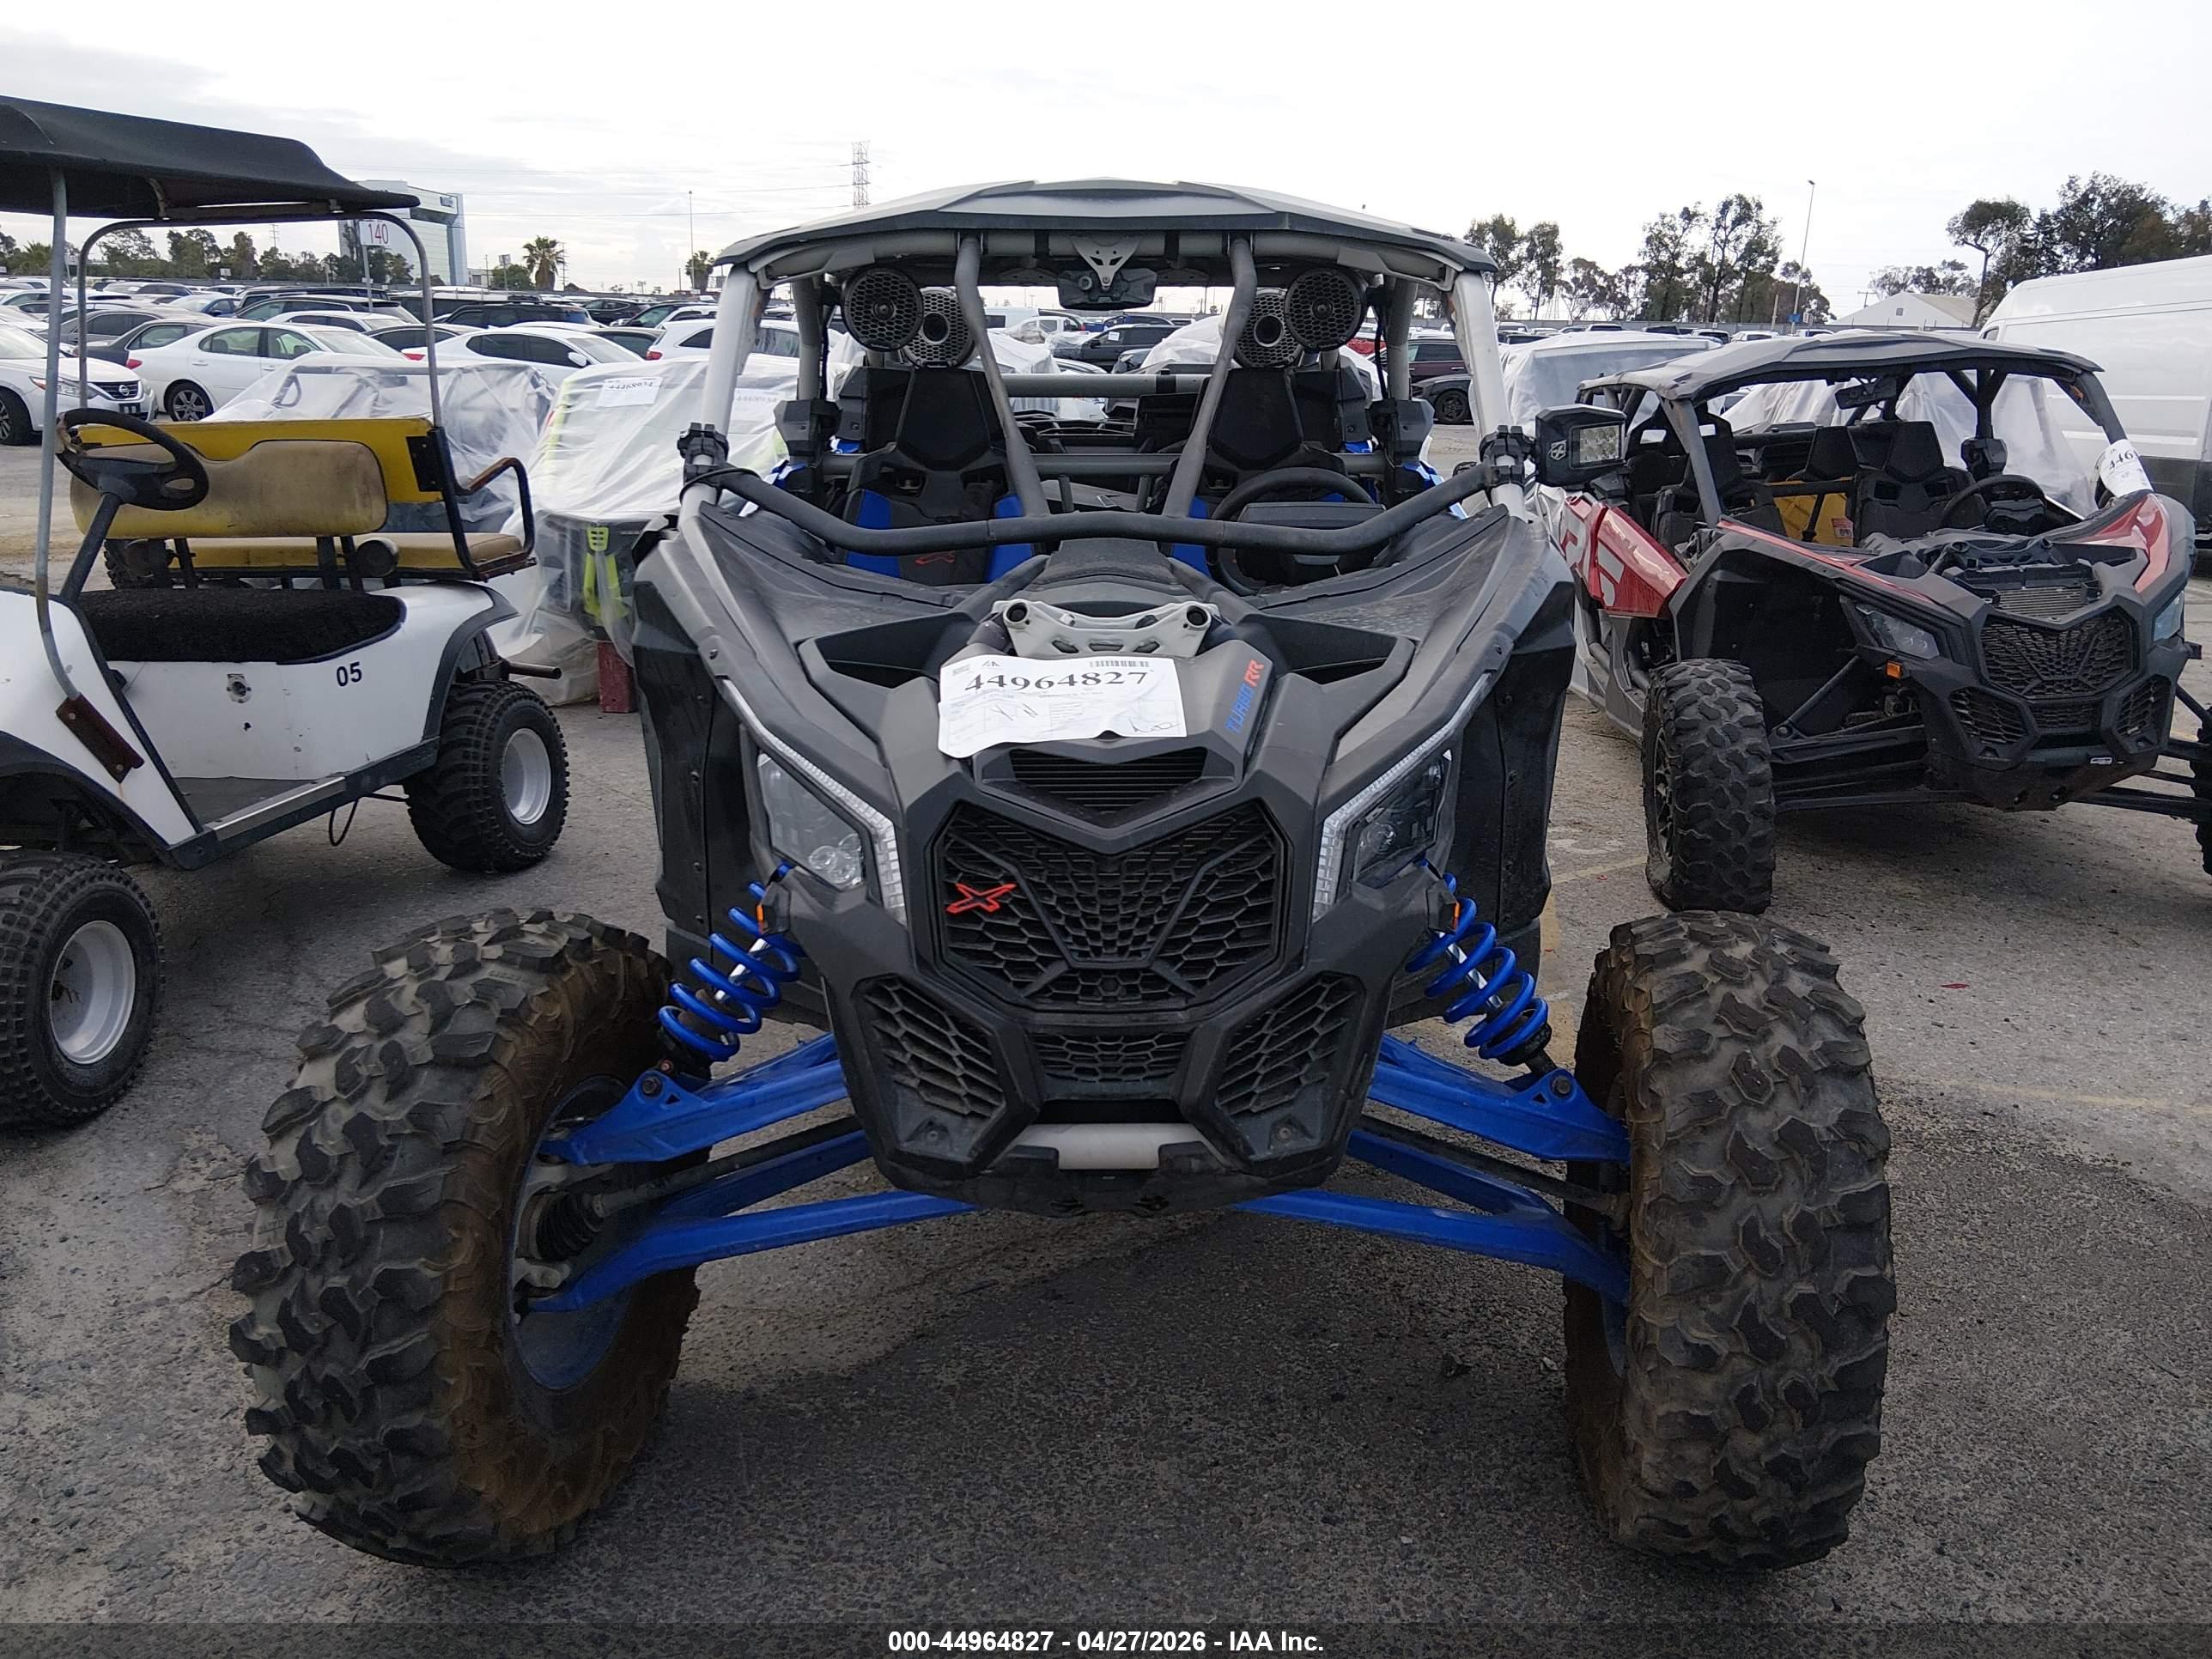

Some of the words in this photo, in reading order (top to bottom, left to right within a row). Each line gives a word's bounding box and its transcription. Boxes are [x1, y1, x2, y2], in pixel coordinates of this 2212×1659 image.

[368, 222, 389, 245] 140
[337, 661, 362, 687] 05
[964, 671, 1147, 690] 44964827
